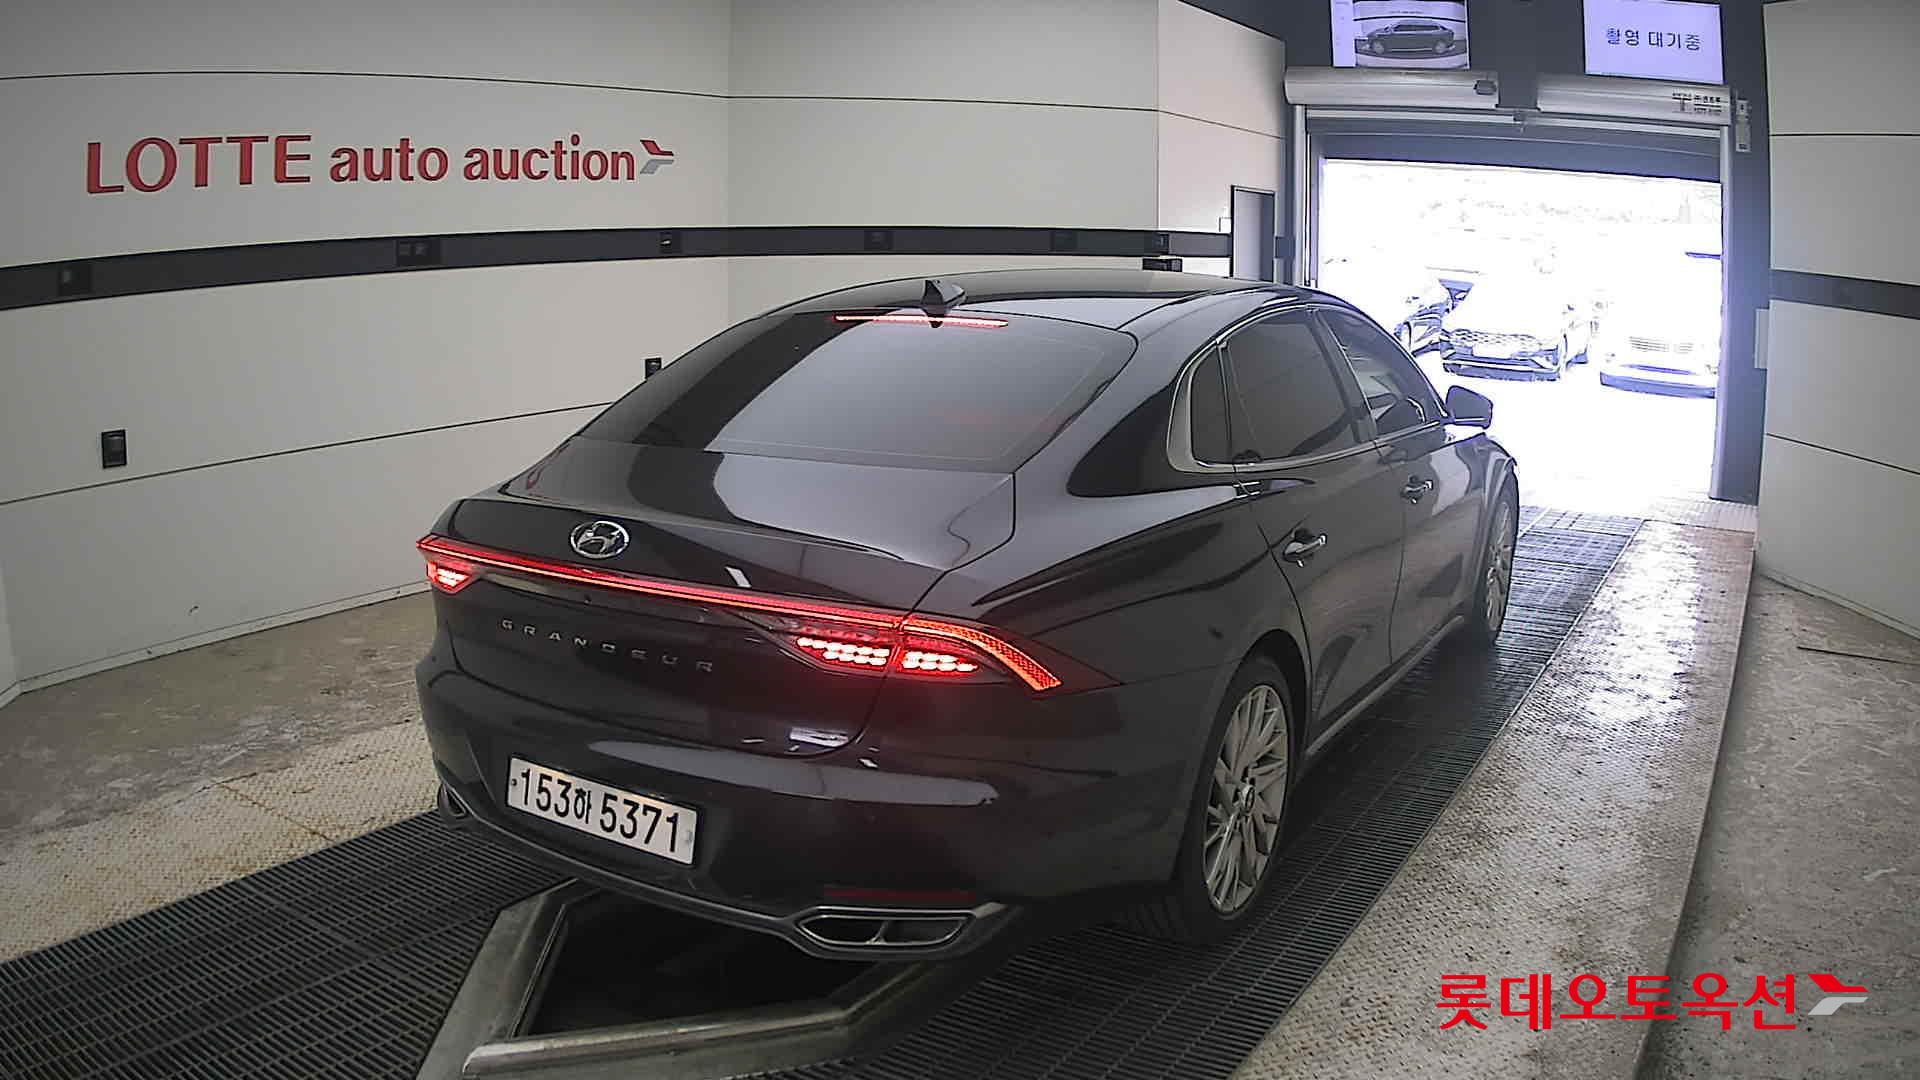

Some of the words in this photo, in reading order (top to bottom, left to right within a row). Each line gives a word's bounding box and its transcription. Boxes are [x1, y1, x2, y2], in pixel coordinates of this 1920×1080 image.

[1607, 27, 1640, 46] 촬영
[1648, 31, 1700, 51] 대기중
[87, 134, 312, 194] LOTTE
[329, 137, 449, 183] auto
[463, 133, 636, 182] auction
[501, 618, 714, 673] GRANDEUR
[599, 792, 680, 854] 5371
